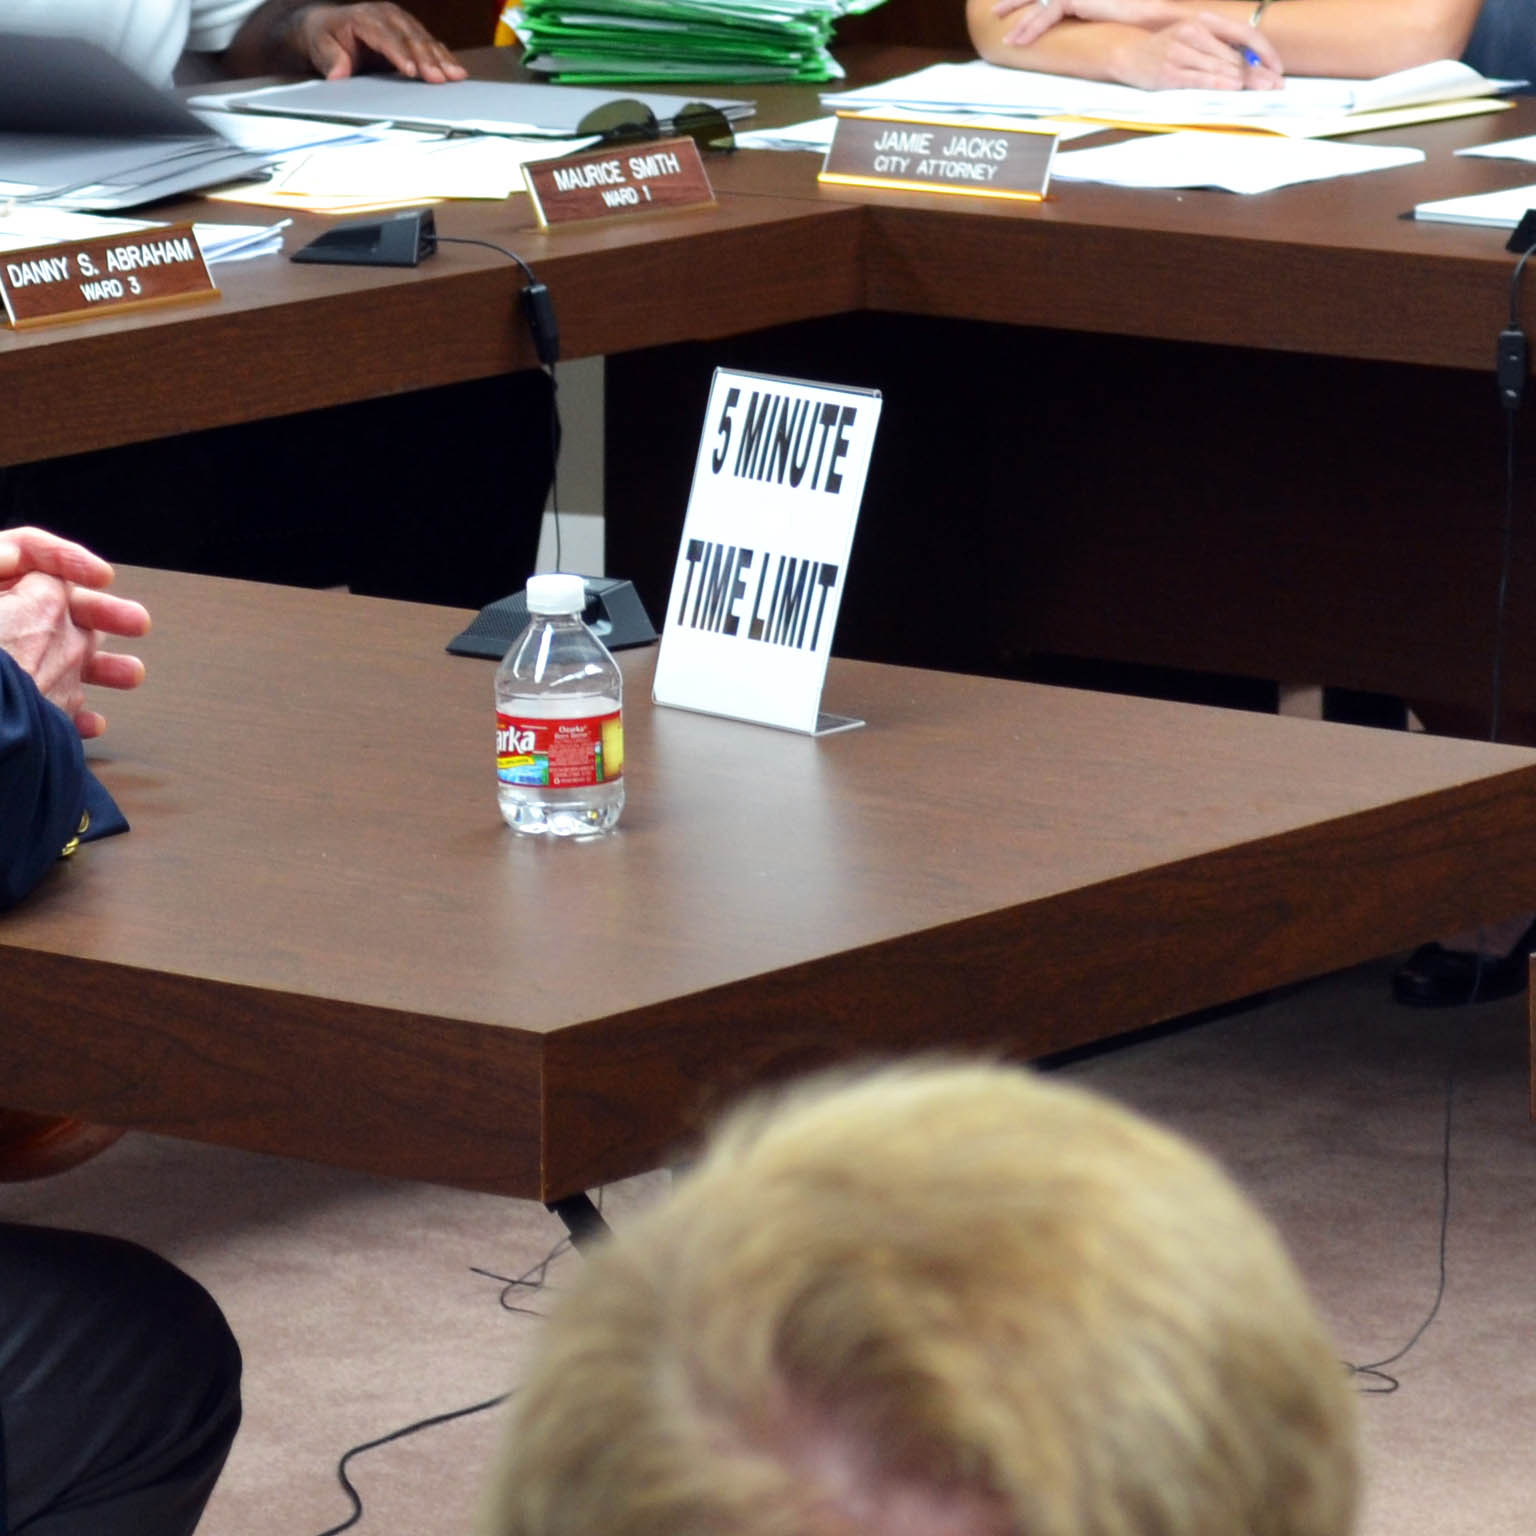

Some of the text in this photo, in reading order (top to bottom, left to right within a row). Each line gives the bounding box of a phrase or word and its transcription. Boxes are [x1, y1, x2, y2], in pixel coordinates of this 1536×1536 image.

[874, 130, 1009, 161] JAMIE JACKS
[552, 152, 681, 193] MAURICE SMITH
[873, 155, 999, 181] CITY ATTORNEY
[601, 185, 653, 209] WARD 1
[6, 237, 195, 289] DANNY S. ABRAHAM
[79, 276, 142, 303] WARD 3
[711, 387, 858, 495] 5 MINUTE
[677, 538, 840, 652] TIME LIMIT
